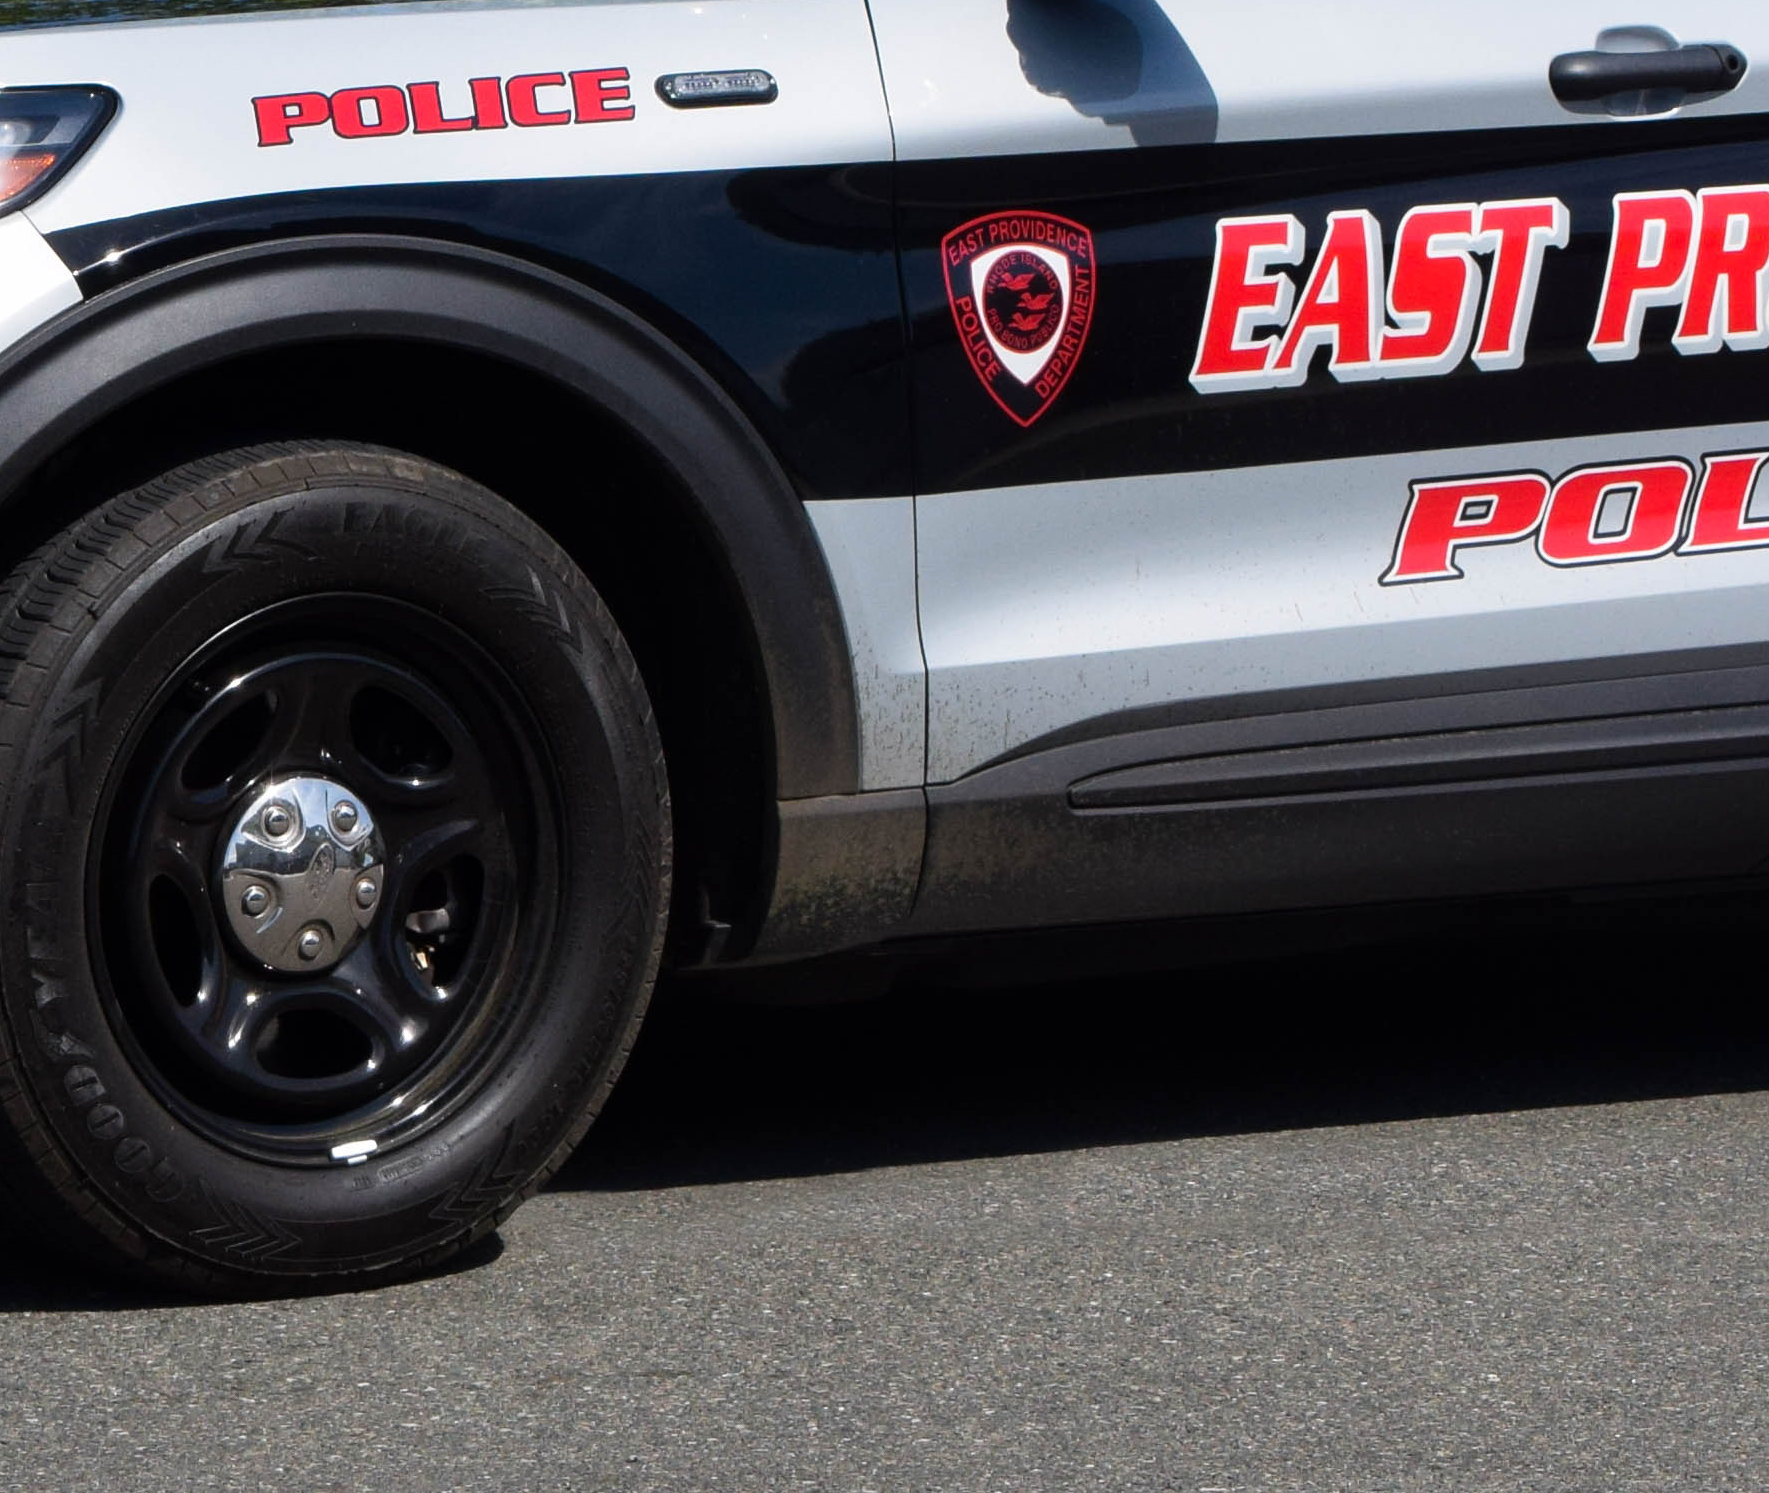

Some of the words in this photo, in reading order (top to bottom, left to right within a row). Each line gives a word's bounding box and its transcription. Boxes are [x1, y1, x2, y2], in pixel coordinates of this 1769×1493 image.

[251, 67, 636, 148] POLICE
[947, 228, 984, 266] EAST
[989, 219, 1088, 259] PROVIDENCE
[1034, 264, 1090, 398] DEPARTMENT
[1189, 196, 1569, 395] EAST
[955, 296, 1002, 381] POLICE
